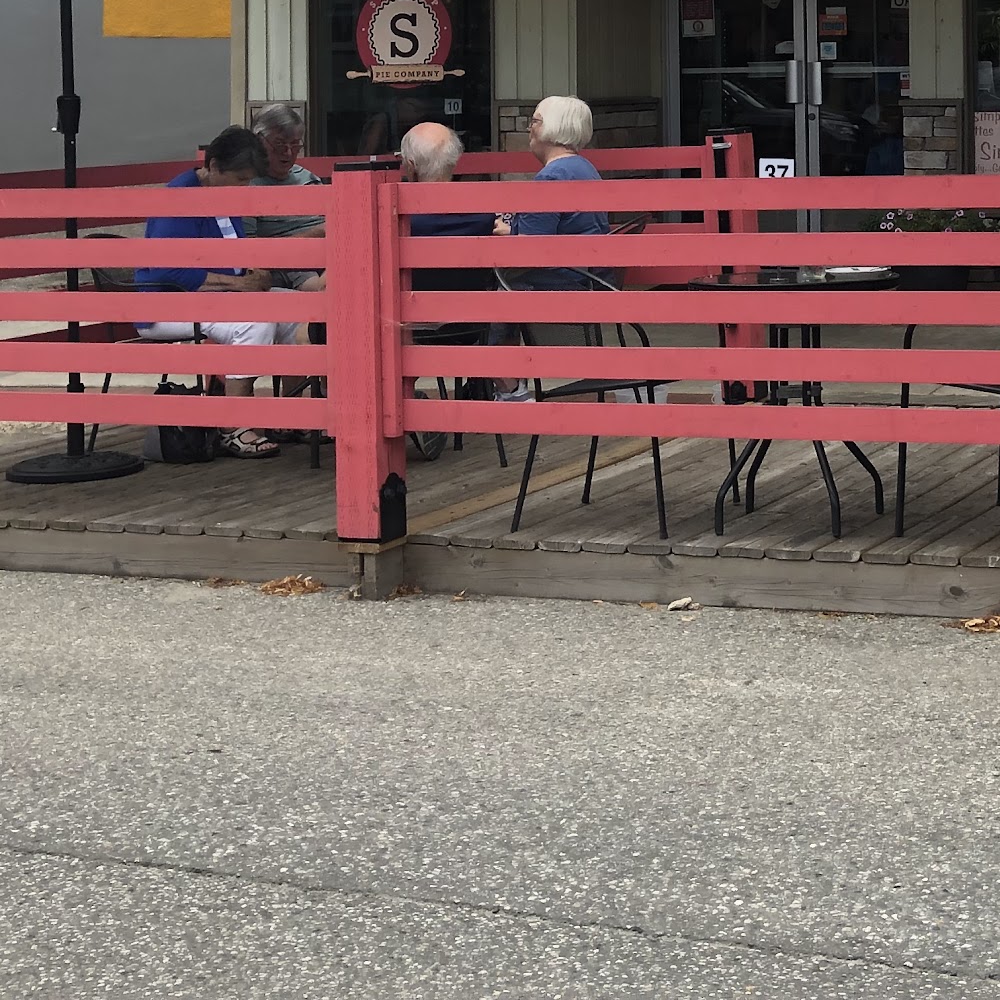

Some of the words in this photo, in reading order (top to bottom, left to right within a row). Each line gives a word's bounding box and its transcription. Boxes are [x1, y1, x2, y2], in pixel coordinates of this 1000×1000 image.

[390, 13, 419, 58] S
[394, 70, 440, 78] COMPANY
[447, 101, 459, 112] 10
